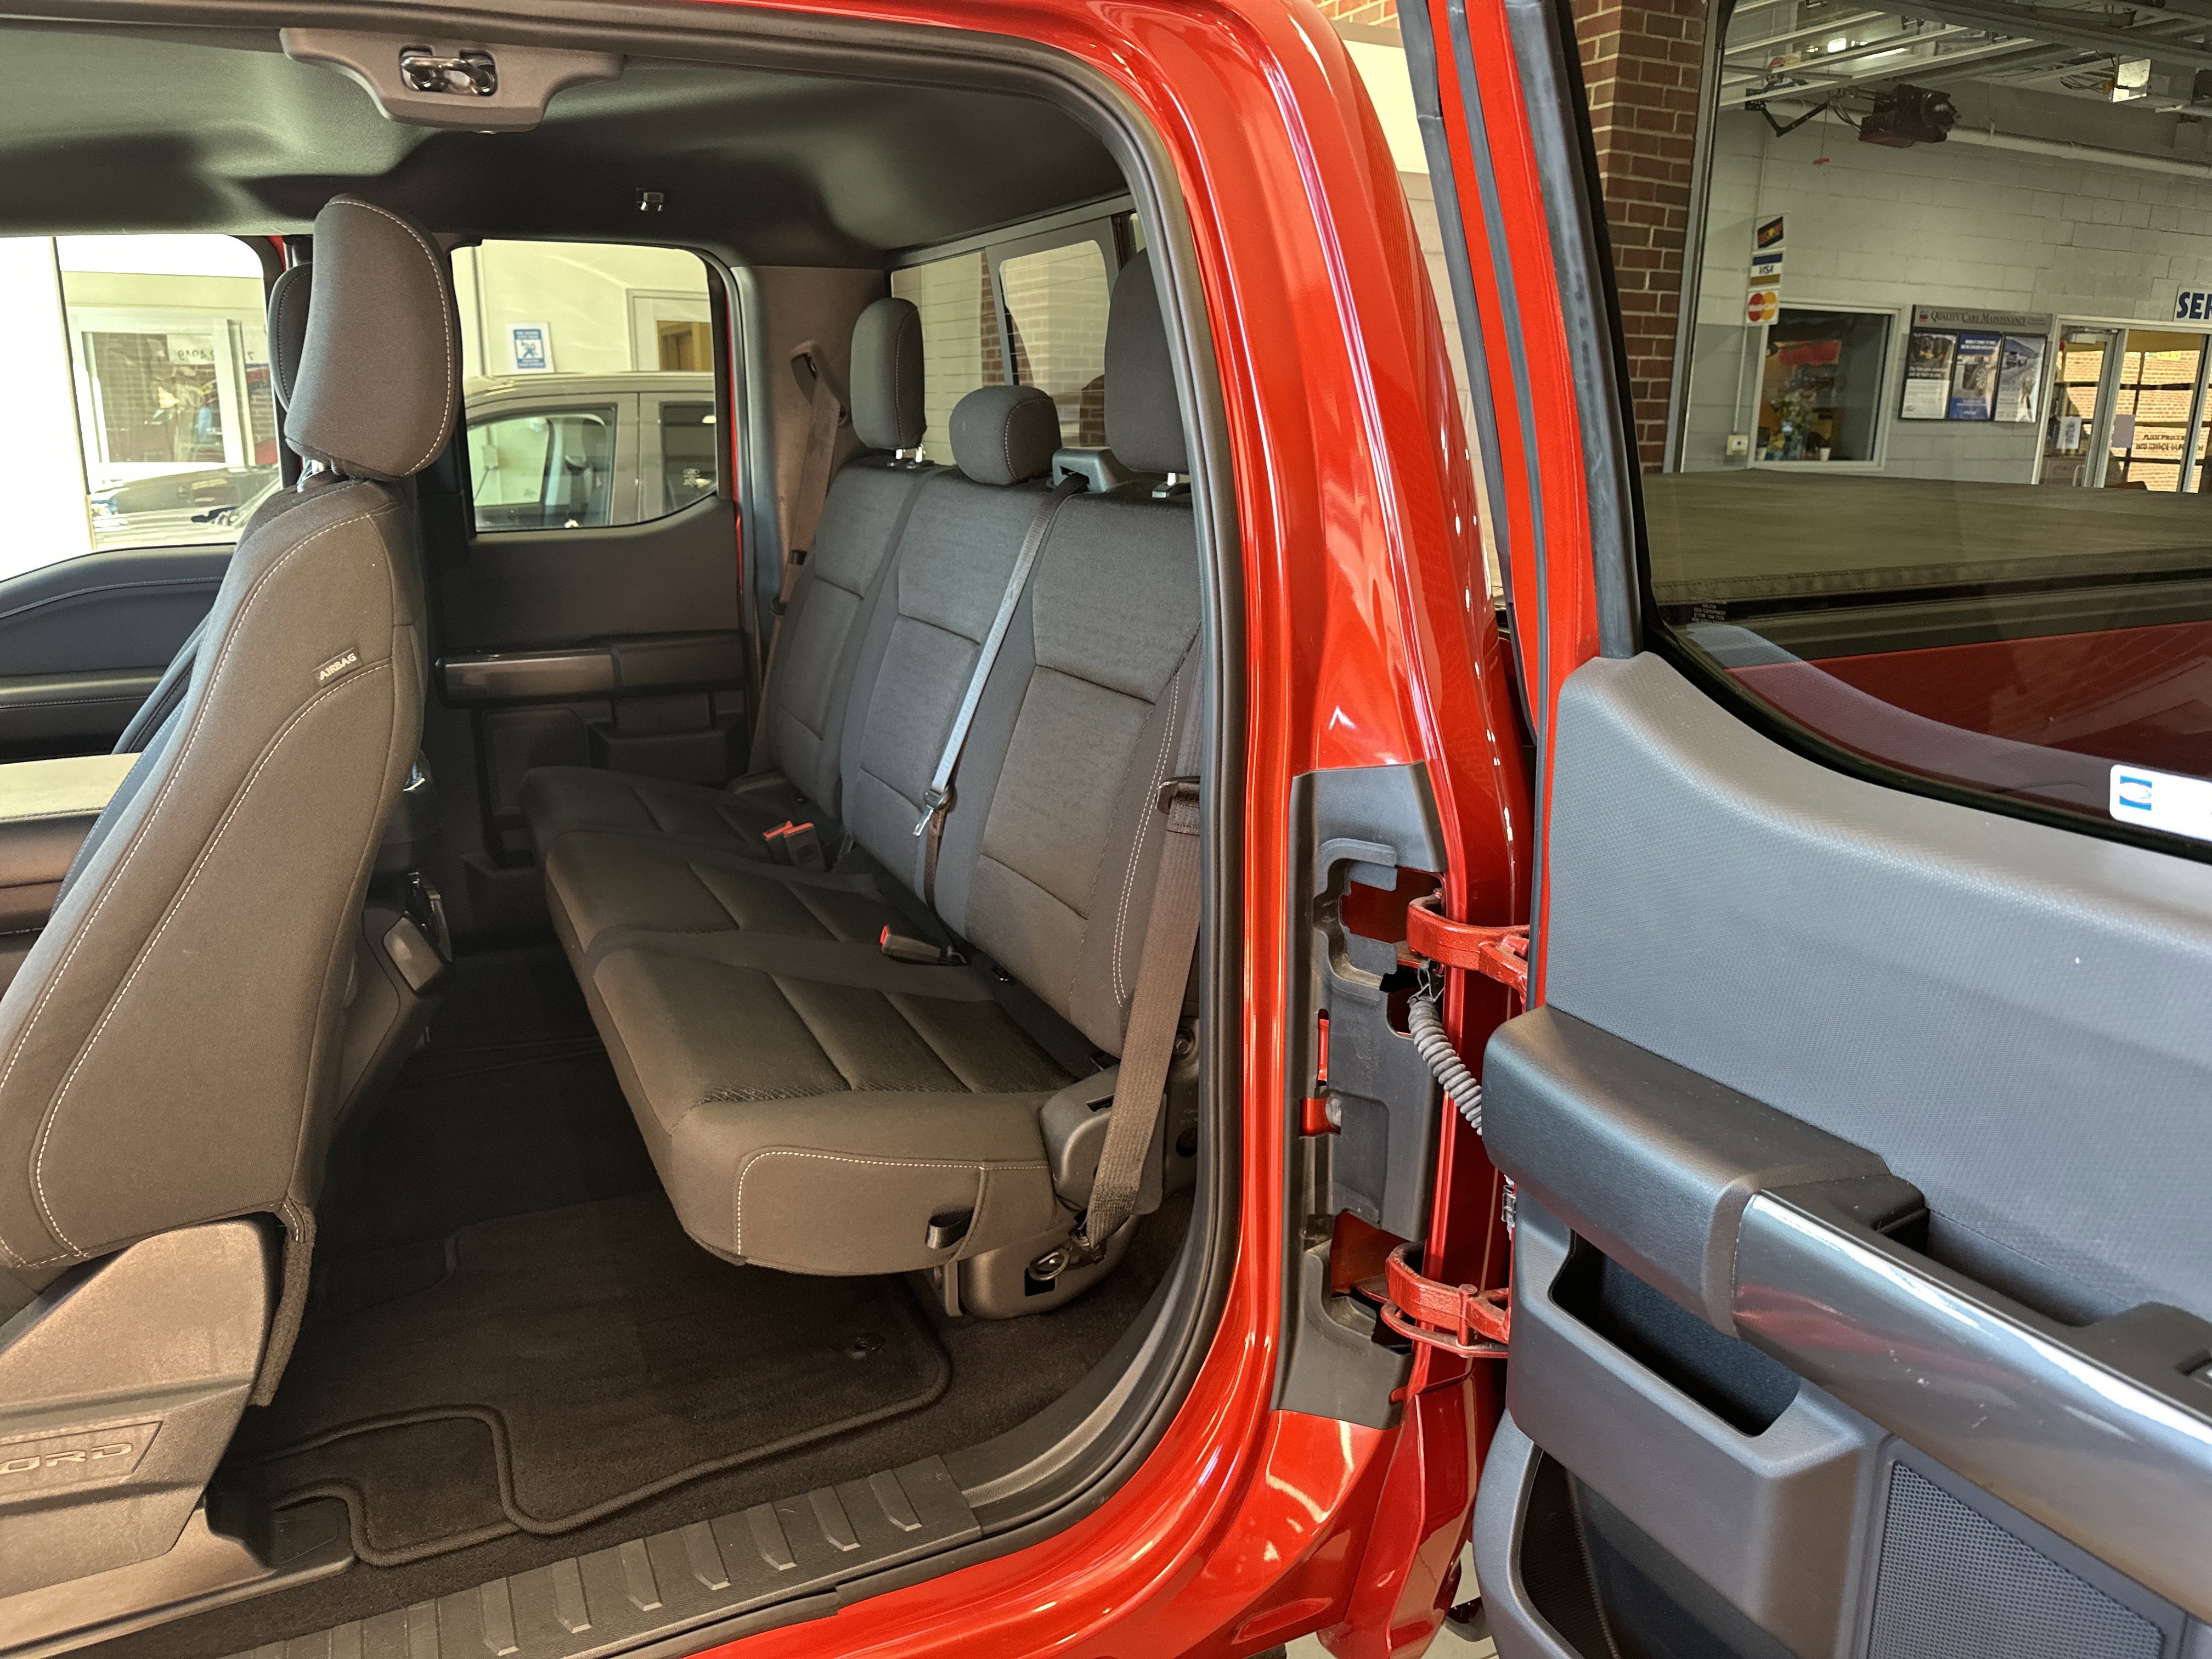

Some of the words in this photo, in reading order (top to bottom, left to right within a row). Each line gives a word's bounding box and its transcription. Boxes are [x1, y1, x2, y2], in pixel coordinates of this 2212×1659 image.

[1759, 265, 1775, 274] VISA
[1931, 311, 1960, 323] QUALITY
[1962, 313, 1980, 324] CARE
[1982, 313, 2026, 326] MAINTENANCE
[320, 653, 357, 680] AIRBAG
